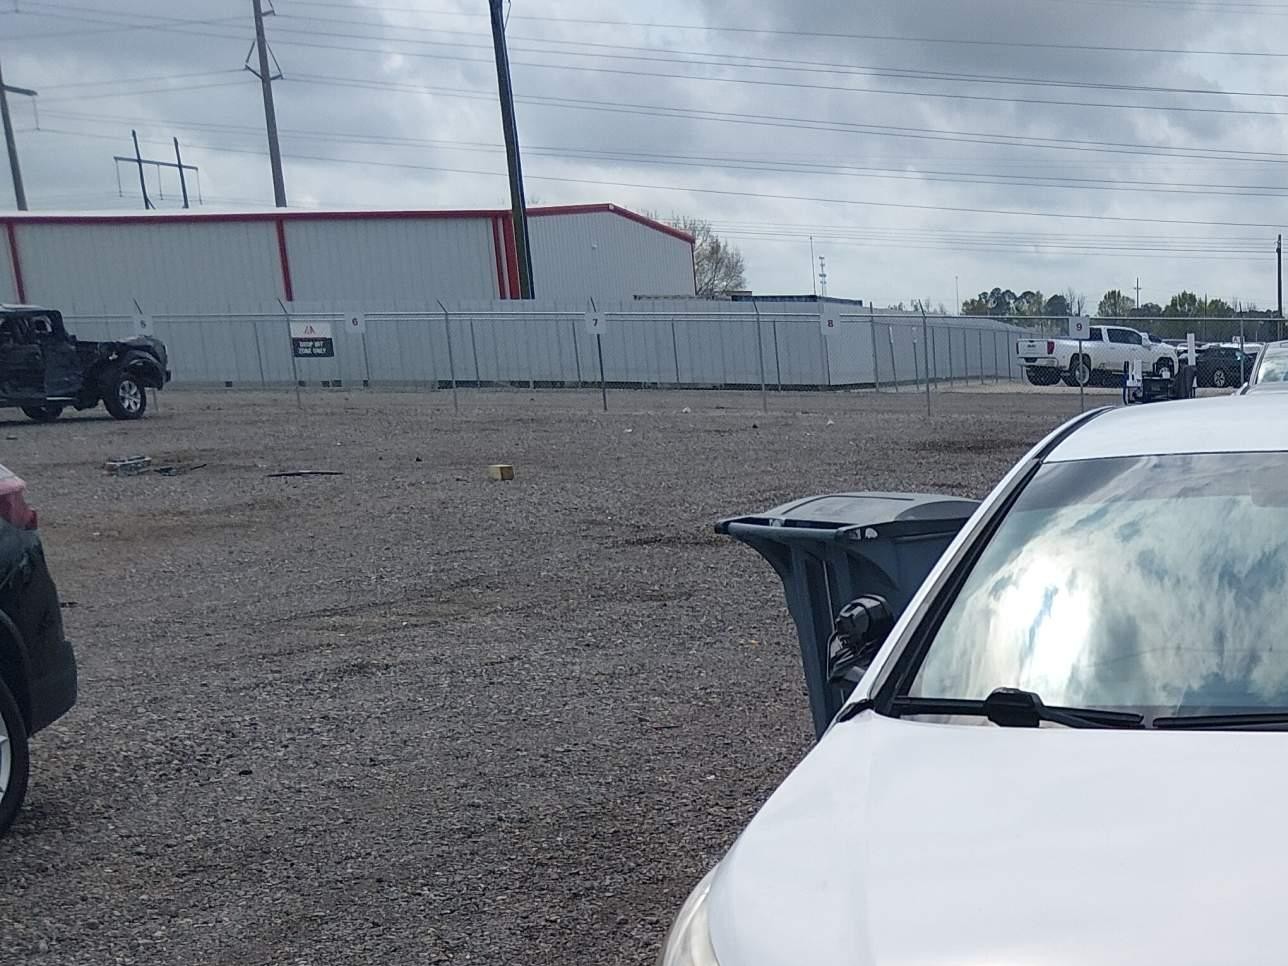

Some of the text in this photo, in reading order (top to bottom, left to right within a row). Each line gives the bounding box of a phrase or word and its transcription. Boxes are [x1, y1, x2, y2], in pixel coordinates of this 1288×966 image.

[352, 318, 358, 326] 6
[592, 318, 598, 326] 7
[827, 319, 833, 327] 8
[1076, 322, 1082, 331] 9
